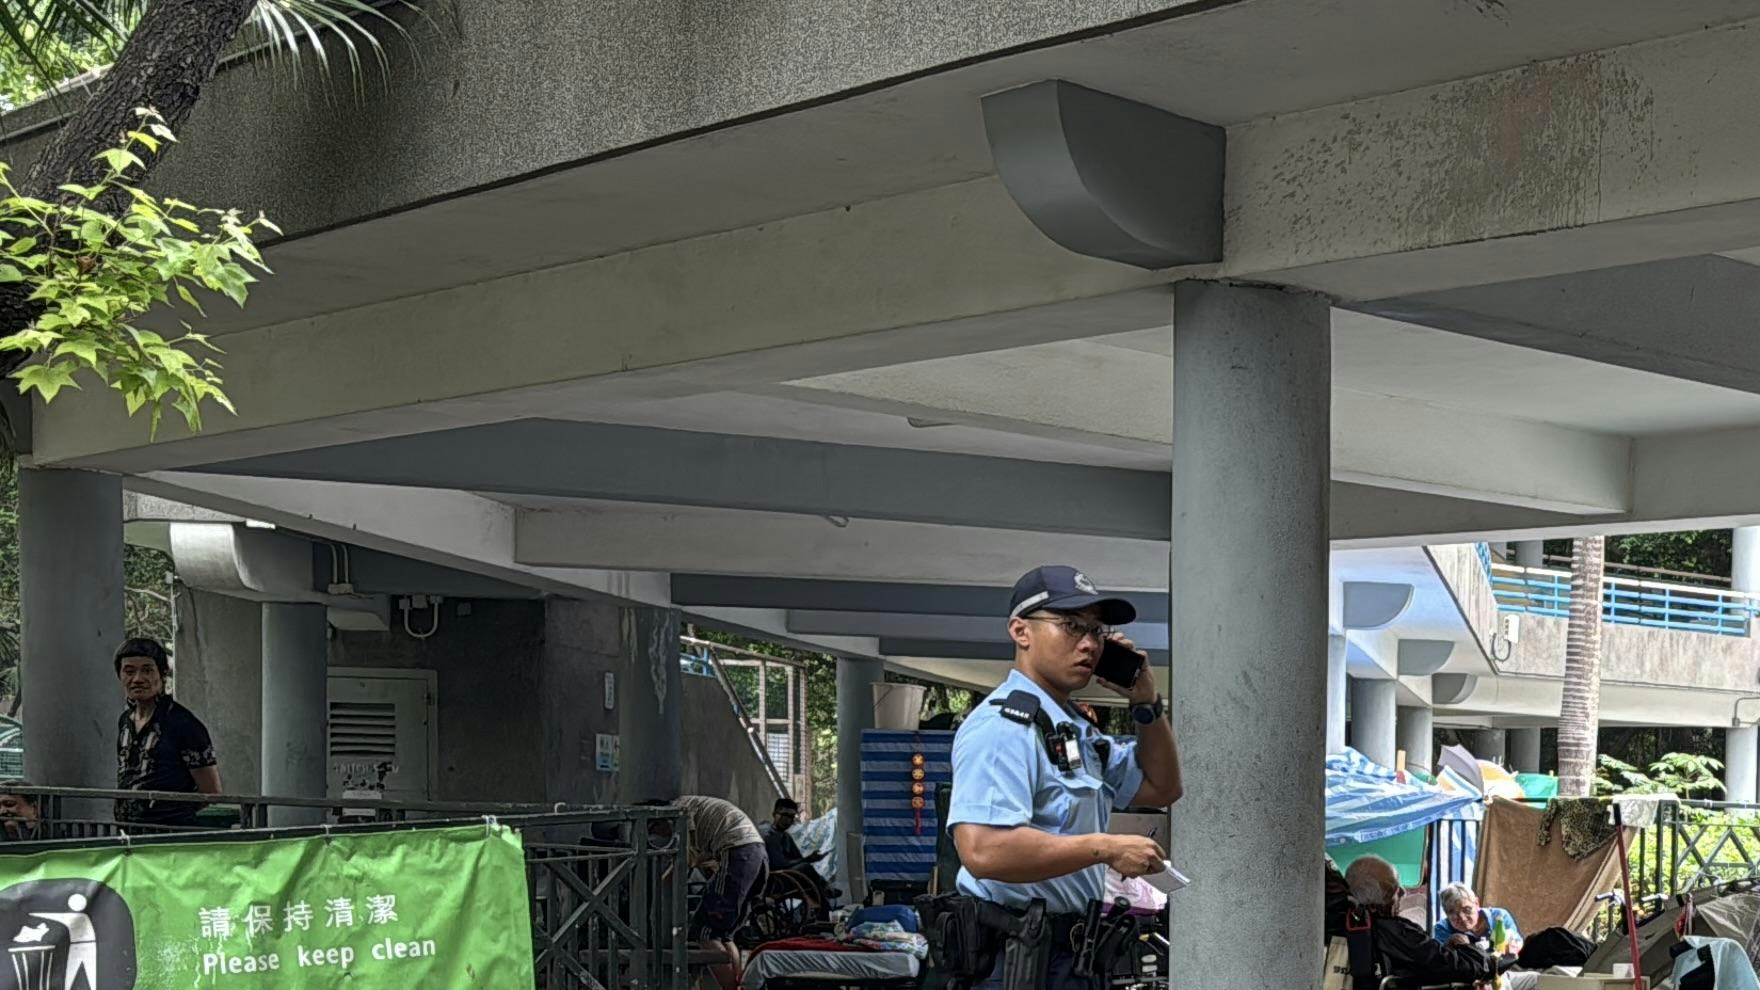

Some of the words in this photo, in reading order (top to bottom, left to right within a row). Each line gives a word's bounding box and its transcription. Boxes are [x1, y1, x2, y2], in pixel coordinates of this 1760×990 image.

[199, 894, 398, 938] 請保持清潔
[203, 951, 280, 976] Please
[297, 945, 355, 968] keep
[371, 937, 437, 960] clean
